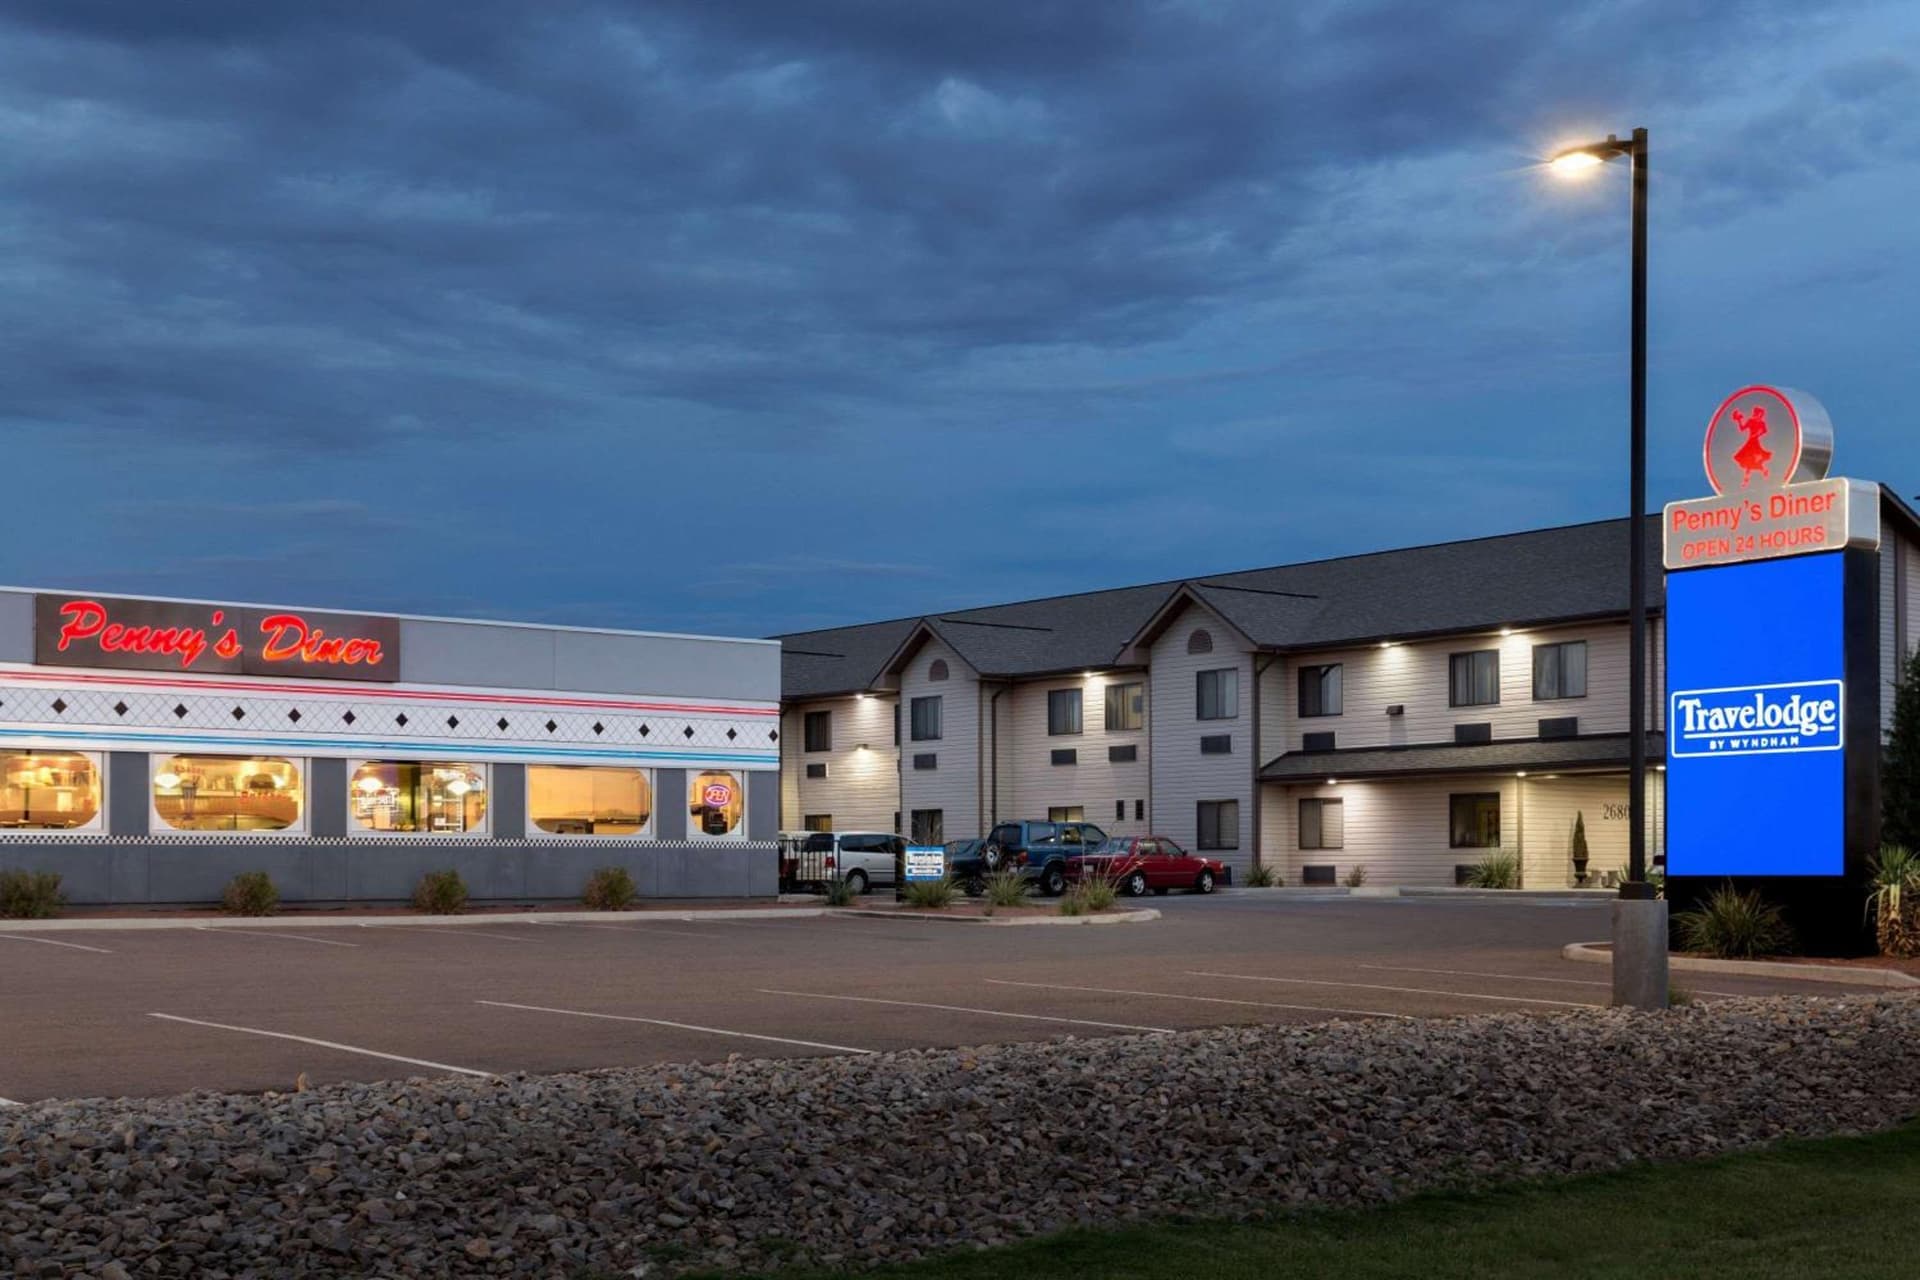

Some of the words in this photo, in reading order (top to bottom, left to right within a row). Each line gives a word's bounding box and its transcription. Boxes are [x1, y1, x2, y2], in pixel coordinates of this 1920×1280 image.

[1672, 499, 1763, 533] Penny's
[1769, 491, 1837, 519] Diner
[1682, 539, 1730, 560] OPEN
[1735, 536, 1754, 553] 24
[1759, 525, 1826, 547] HOURS
[57, 600, 243, 669] Penny's
[260, 613, 384, 666] Diner
[1678, 693, 1836, 736] Travelodge
[1709, 740, 1724, 750] BY
[1730, 736, 1800, 749] WYNDHAM
